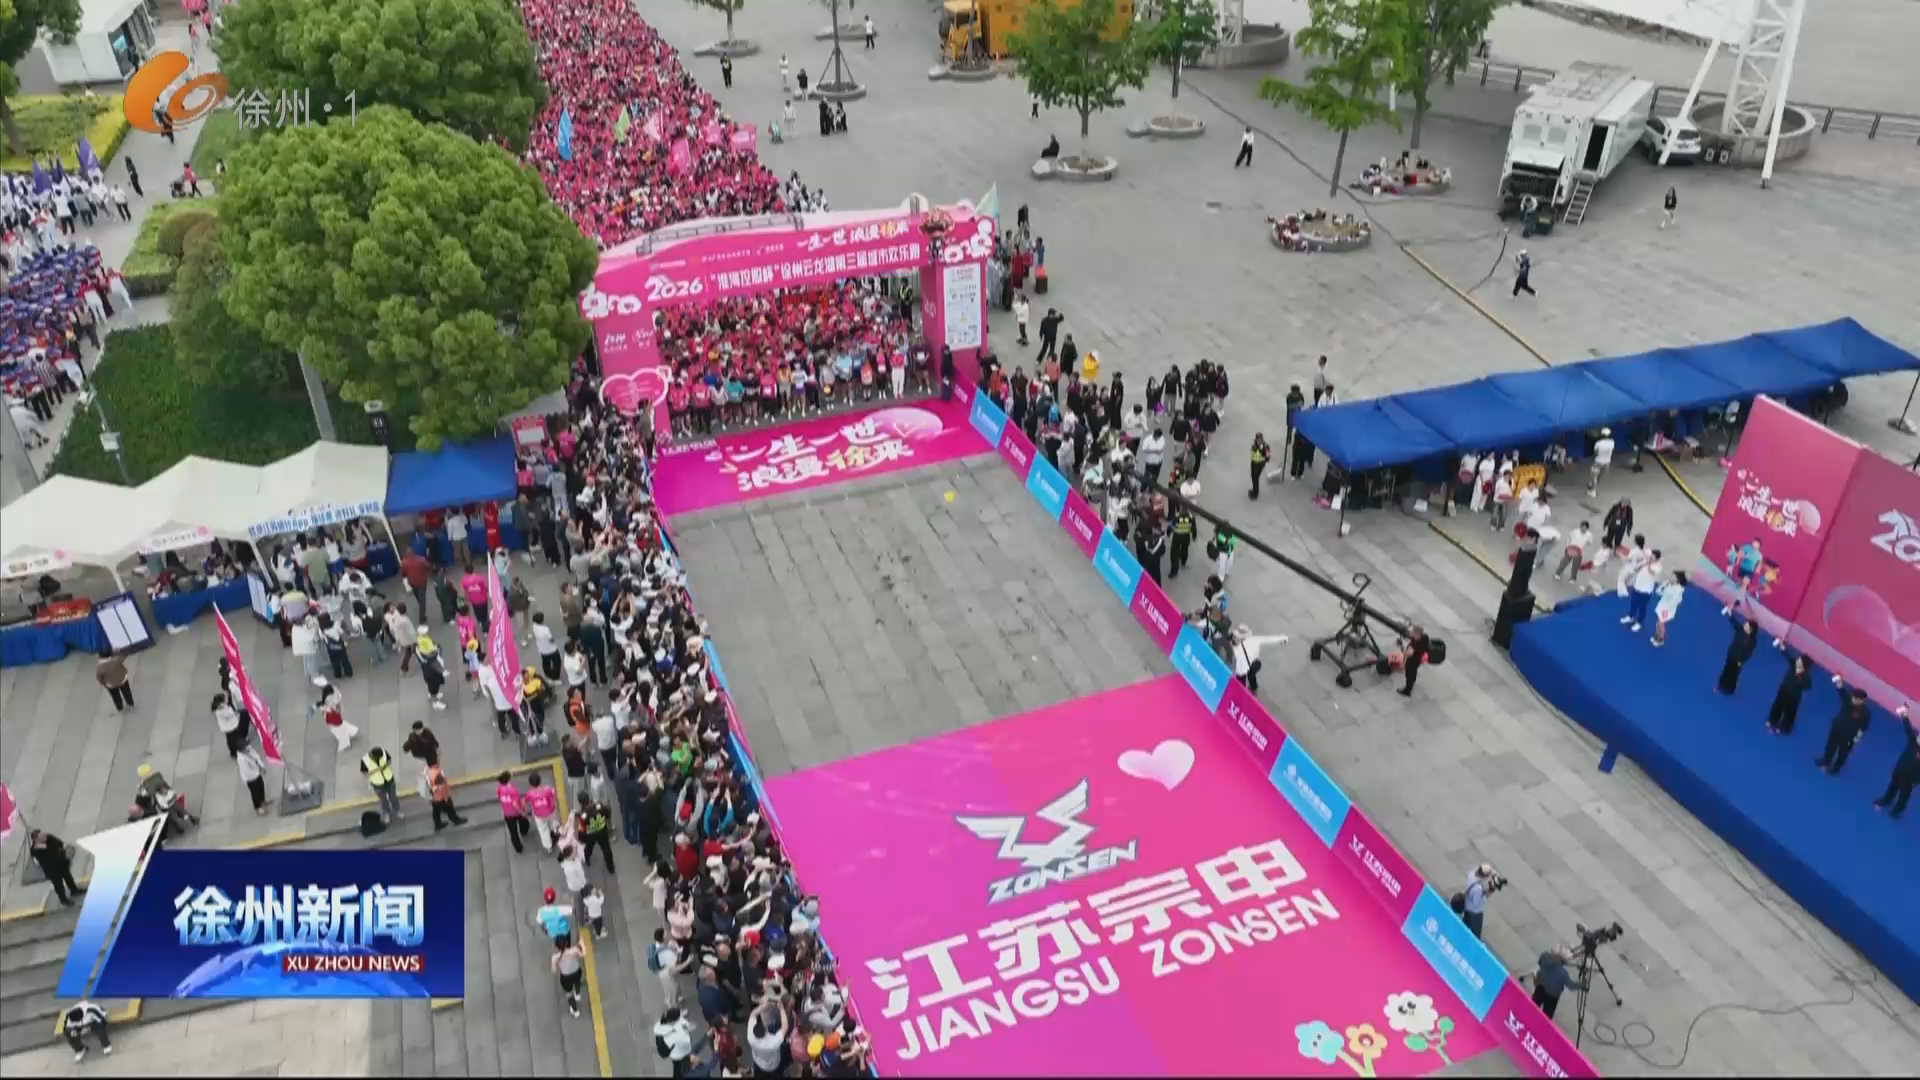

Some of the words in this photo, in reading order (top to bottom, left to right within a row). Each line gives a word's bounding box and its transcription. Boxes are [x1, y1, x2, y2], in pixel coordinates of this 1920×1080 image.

[644, 273, 704, 301] 2026
[865, 839, 1308, 1018] 江苏宗申
[988, 839, 1138, 903] ZONSEN
[897, 956, 1120, 1060] JIANGSU
[1140, 888, 1340, 978] ZONSEN
